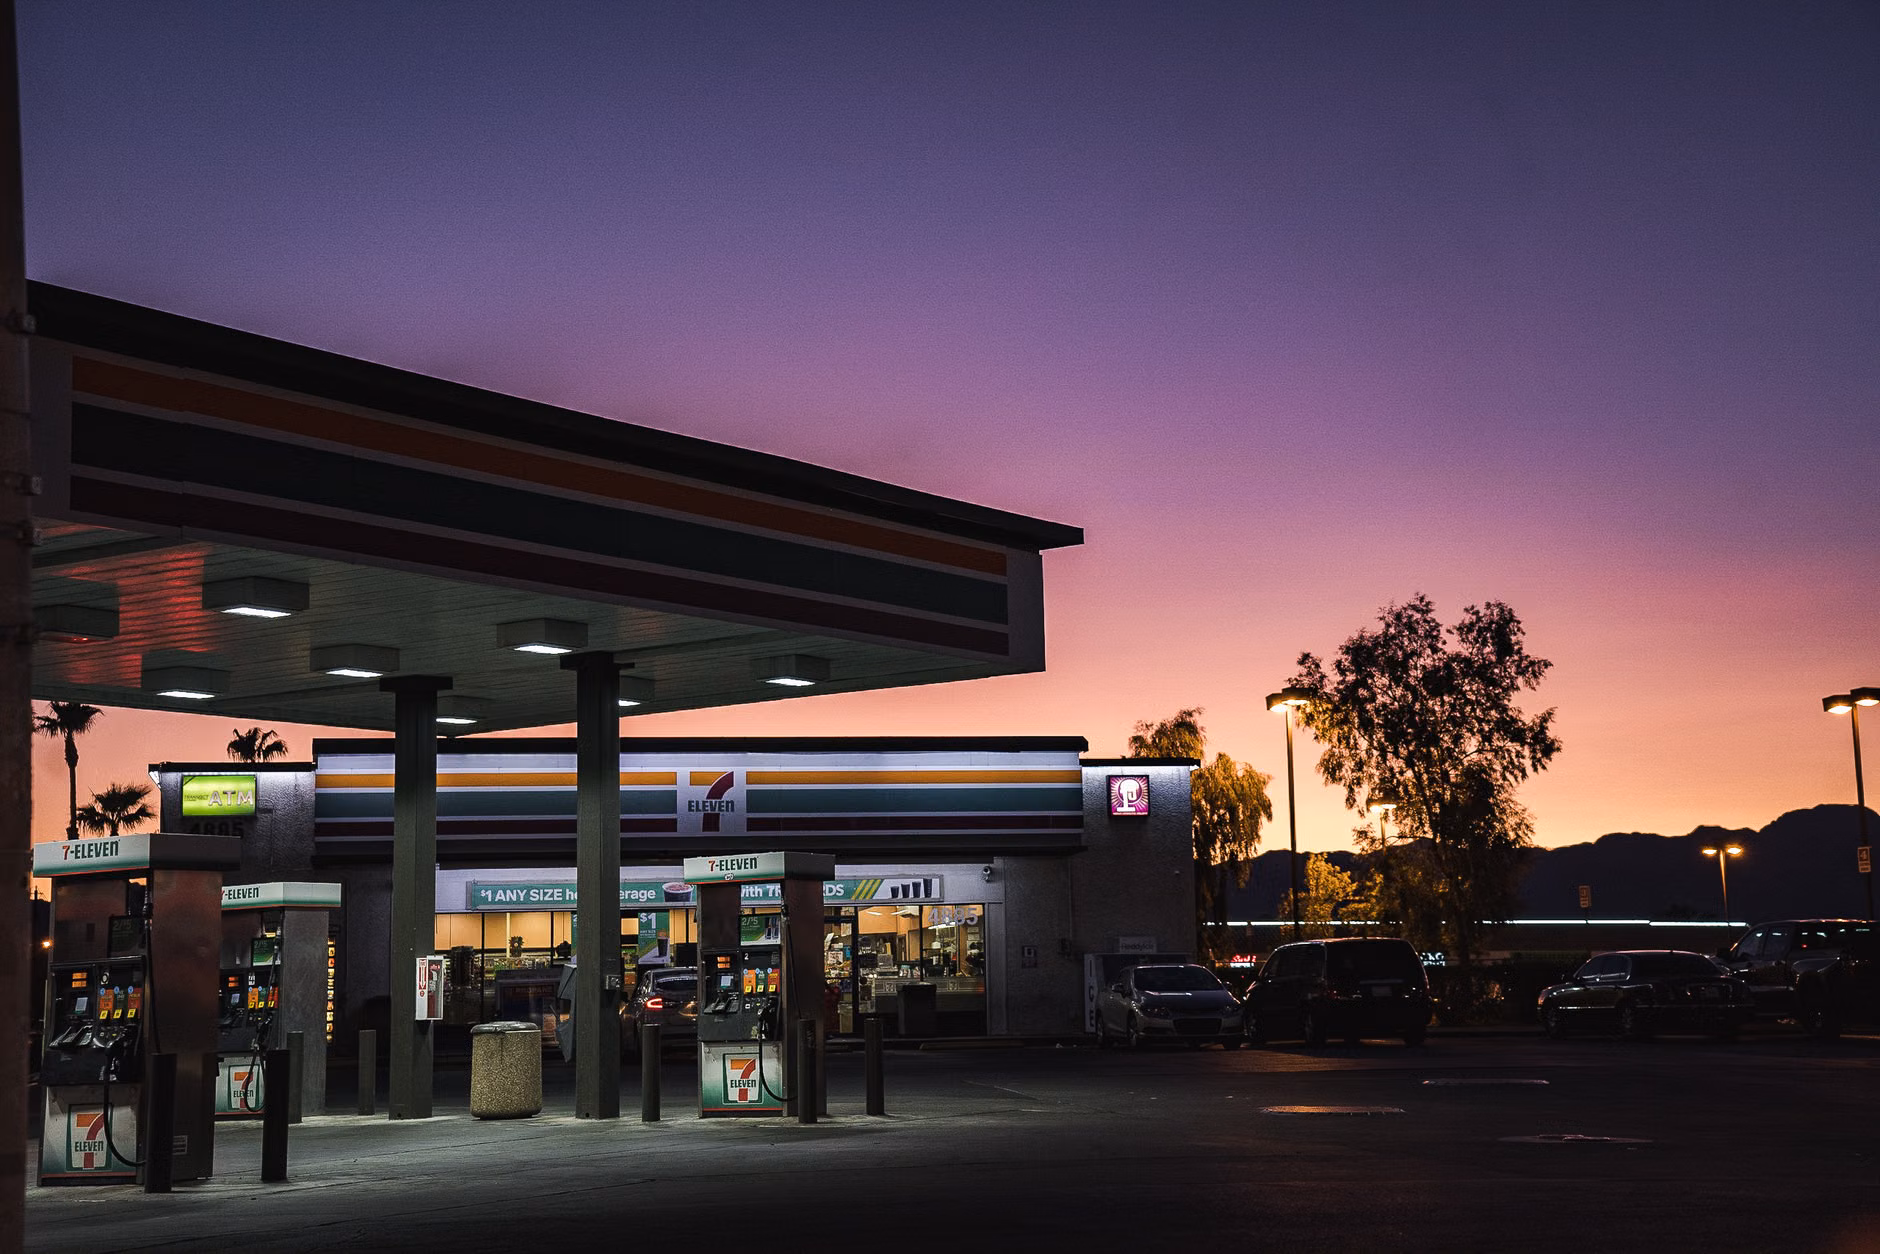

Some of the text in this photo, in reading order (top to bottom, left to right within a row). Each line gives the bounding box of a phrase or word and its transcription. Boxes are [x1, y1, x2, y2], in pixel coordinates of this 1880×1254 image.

[208, 791, 254, 806] ATM
[480, 888, 491, 902] $1
[495, 888, 527, 902] ANY
[530, 888, 562, 901] SIZE
[640, 912, 657, 929] $1
